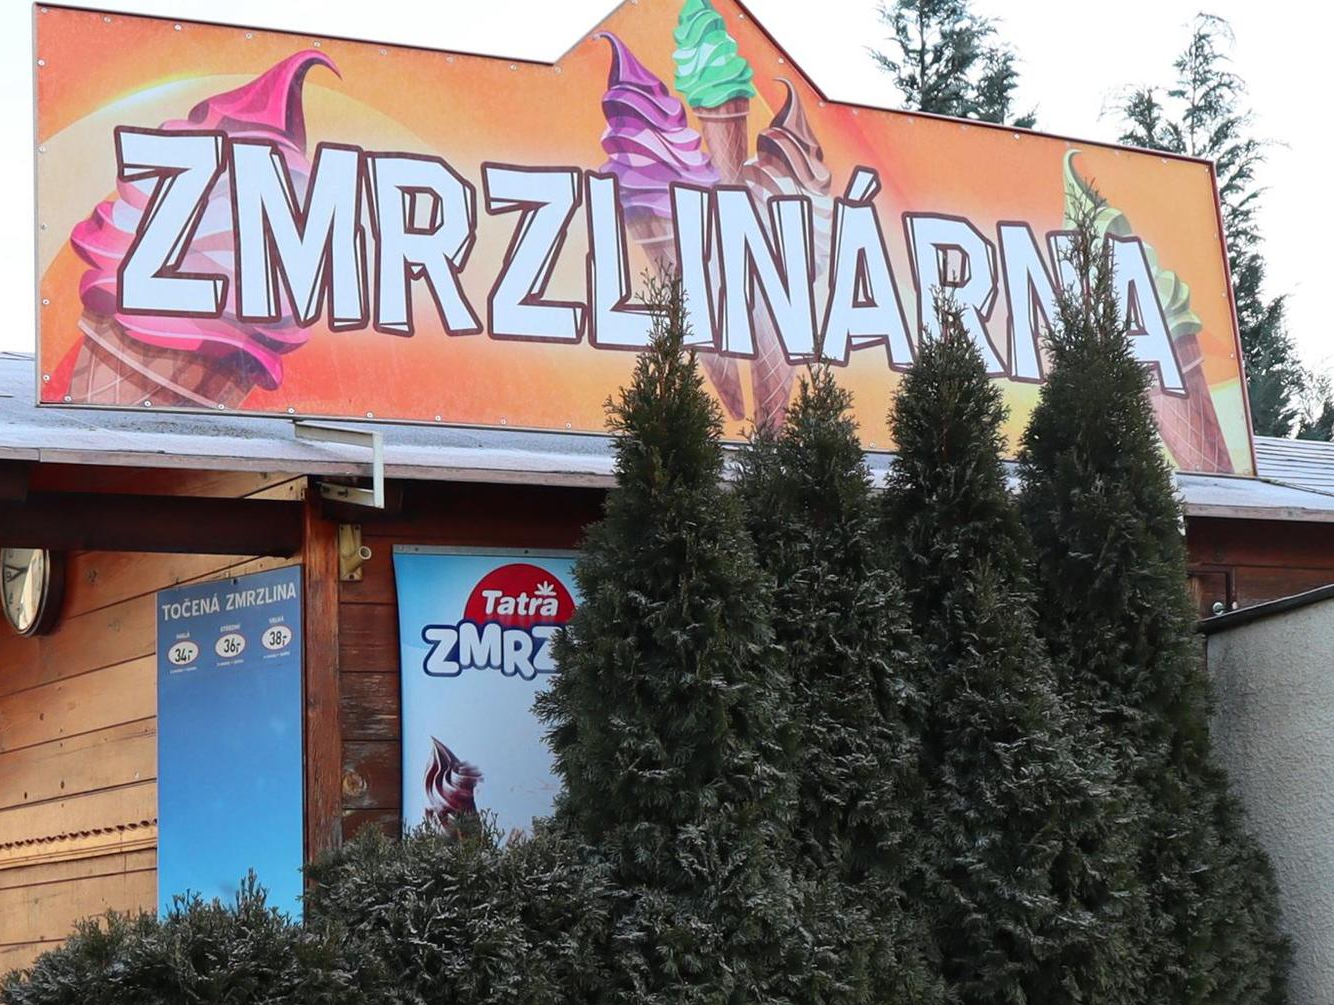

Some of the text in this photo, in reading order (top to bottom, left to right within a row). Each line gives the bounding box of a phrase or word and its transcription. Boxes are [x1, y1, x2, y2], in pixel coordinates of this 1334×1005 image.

[114, 125, 1190, 399] ZMRZLINÁRNA
[162, 582, 297, 621] TOČENÁ ZMRZLINA
[481, 589, 559, 616] Tatra
